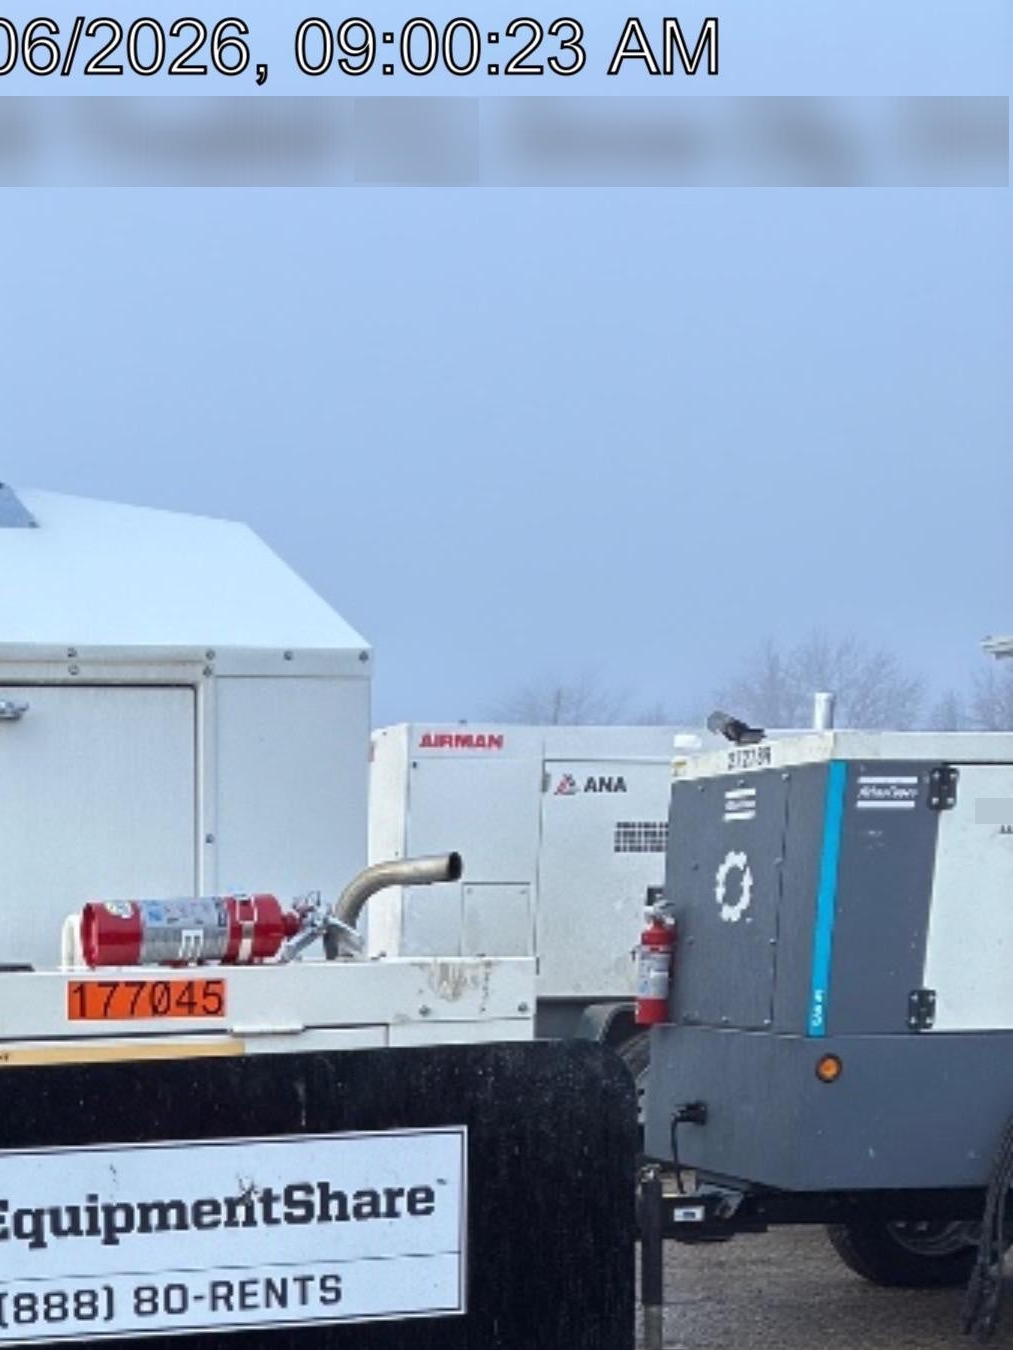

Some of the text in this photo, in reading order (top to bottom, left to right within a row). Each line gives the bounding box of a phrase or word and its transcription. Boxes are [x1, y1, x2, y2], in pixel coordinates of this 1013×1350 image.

[419, 734, 503, 748] AIRMAN
[584, 776, 627, 793] ANA
[73, 980, 223, 1017] 177045
[133, 1274, 342, 1316] 80-RENTS
